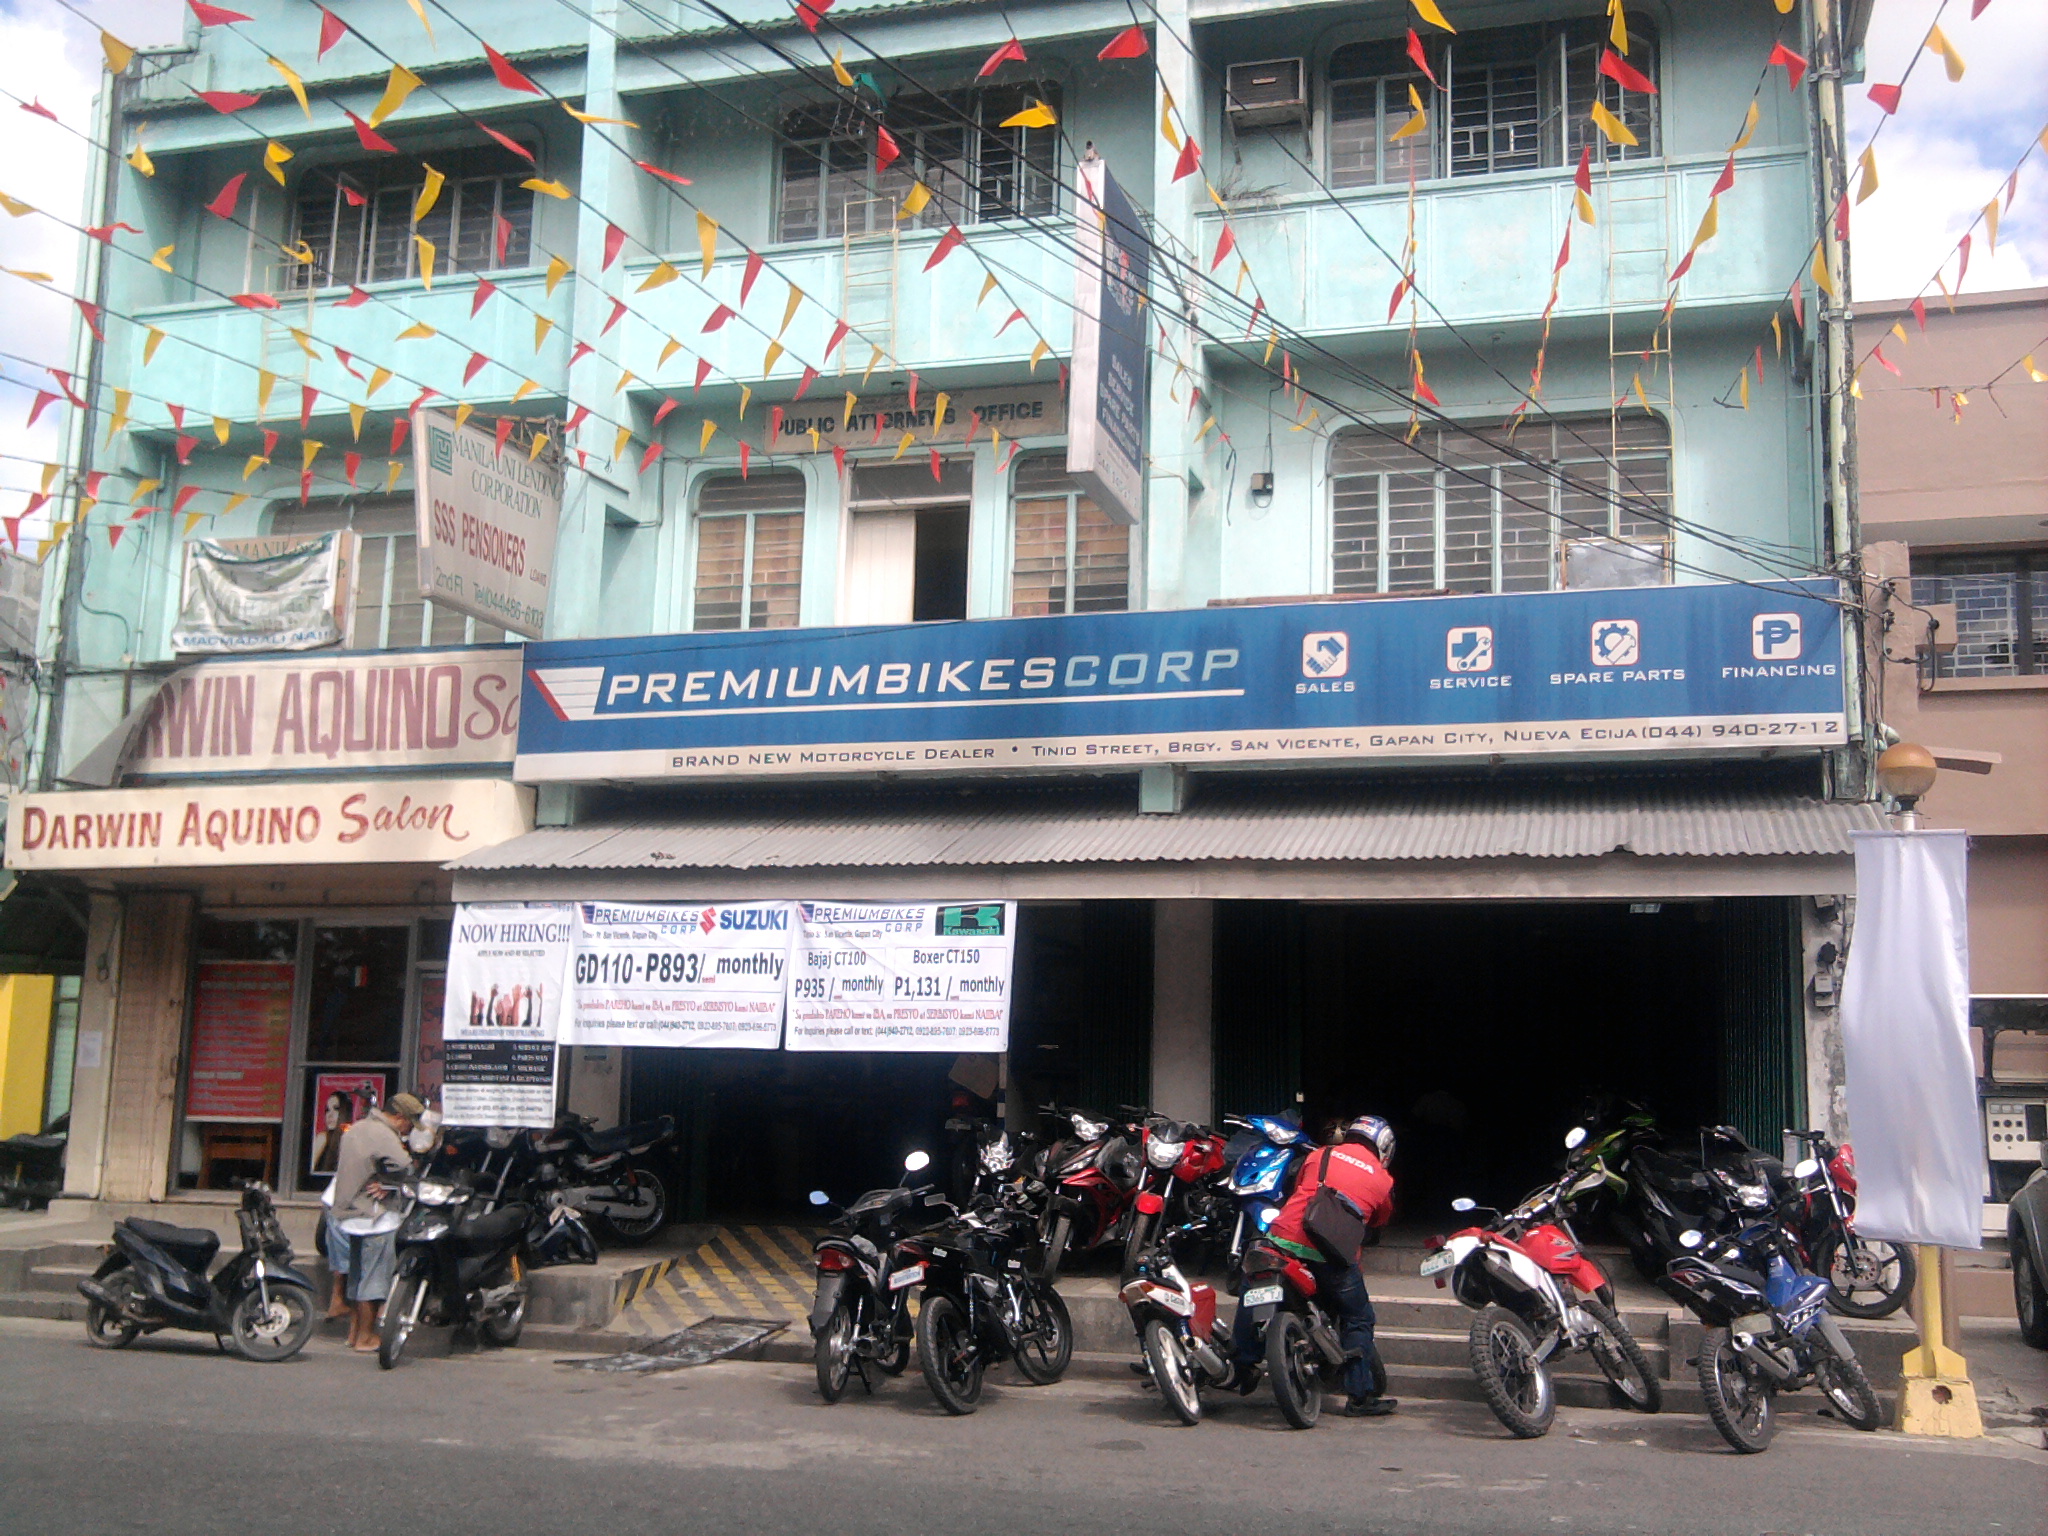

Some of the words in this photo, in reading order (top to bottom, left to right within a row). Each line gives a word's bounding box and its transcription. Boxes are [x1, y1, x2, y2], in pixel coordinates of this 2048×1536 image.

[471, 469, 543, 519] CORPORATION
[434, 498, 456, 547] SSS
[462, 512, 526, 577] PENSIONERS
[1550, 671, 1615, 685] SPARE
[1622, 669, 1686, 682] PARTS
[1722, 664, 1837, 679] FINANCING
[1295, 681, 1356, 694] SALES
[1429, 675, 1512, 690] SERVICE
[272, 665, 463, 760] AQUINO
[672, 754, 740, 768] BRAND
[749, 752, 791, 764] NEW
[1711, 720, 1839, 737] 940-27-12
[22, 806, 163, 851] DARWIN
[178, 802, 321, 852] AQUINO
[337, 793, 470, 843] Salon
[595, 908, 700, 923] PREMIUMBIKES
[719, 909, 789, 931] SUZUKI
[815, 907, 926, 922] PREMIUMBIKES
[458, 923, 498, 943] NOW
[499, 923, 571, 943] HIRING!!!
[660, 925, 697, 935] CORP
[885, 922, 923, 933] CORP
[716, 952, 785, 980] monthly
[808, 951, 832, 969] Bajaj
[834, 951, 867, 967] CT100
[913, 949, 944, 964] Boxer
[946, 948, 981, 964] CT150
[795, 977, 826, 998] P935
[841, 974, 884, 995] monthly
[894, 976, 942, 1001] P1,131
[959, 974, 1005, 996] monthly
